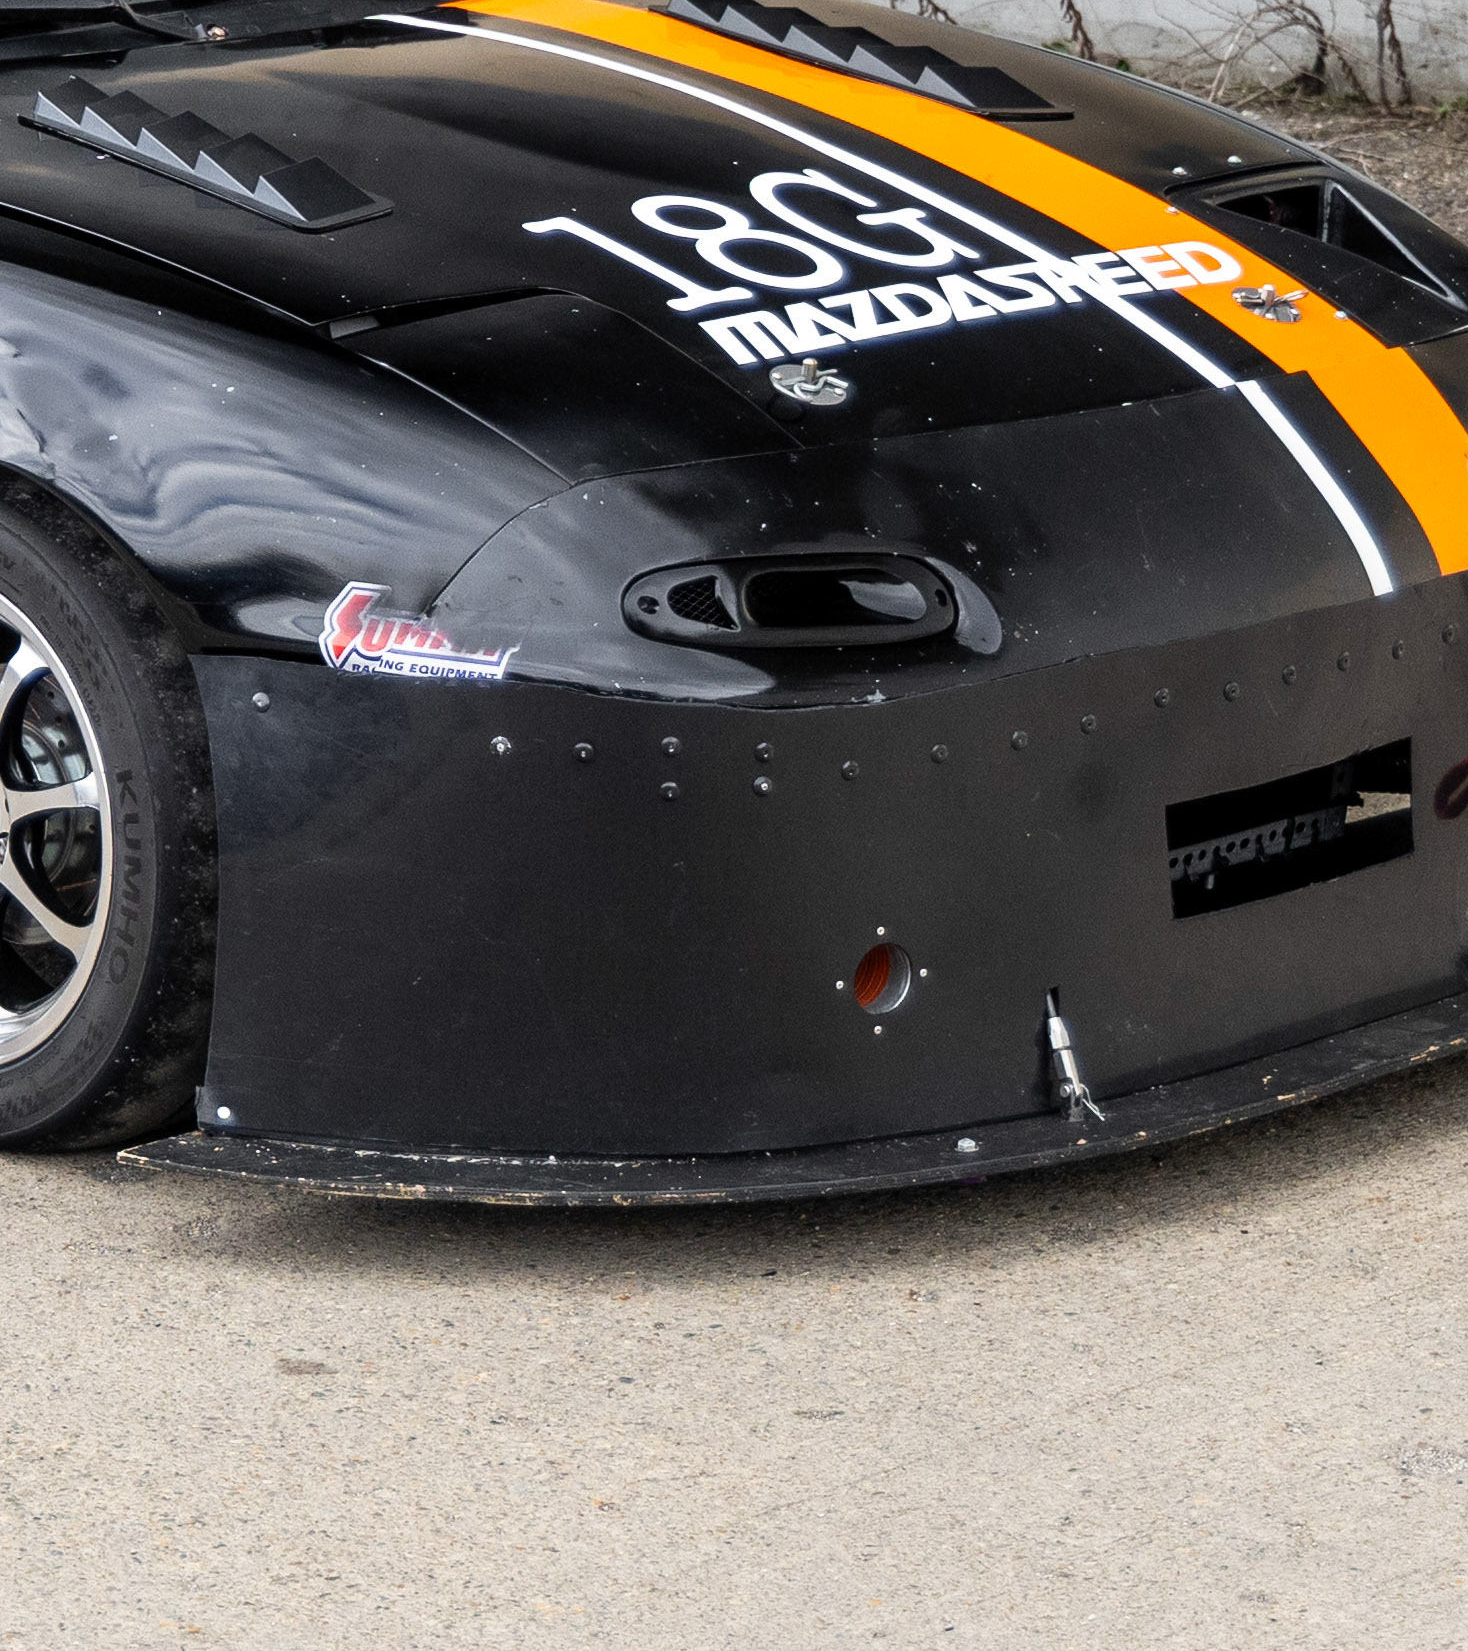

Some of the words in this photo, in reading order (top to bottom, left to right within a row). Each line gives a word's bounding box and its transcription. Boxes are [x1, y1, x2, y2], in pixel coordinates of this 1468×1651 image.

[522, 168, 980, 312] 18G
[698, 241, 1243, 366] MAZDASPEED
[109, 769, 142, 985] KUMHO
